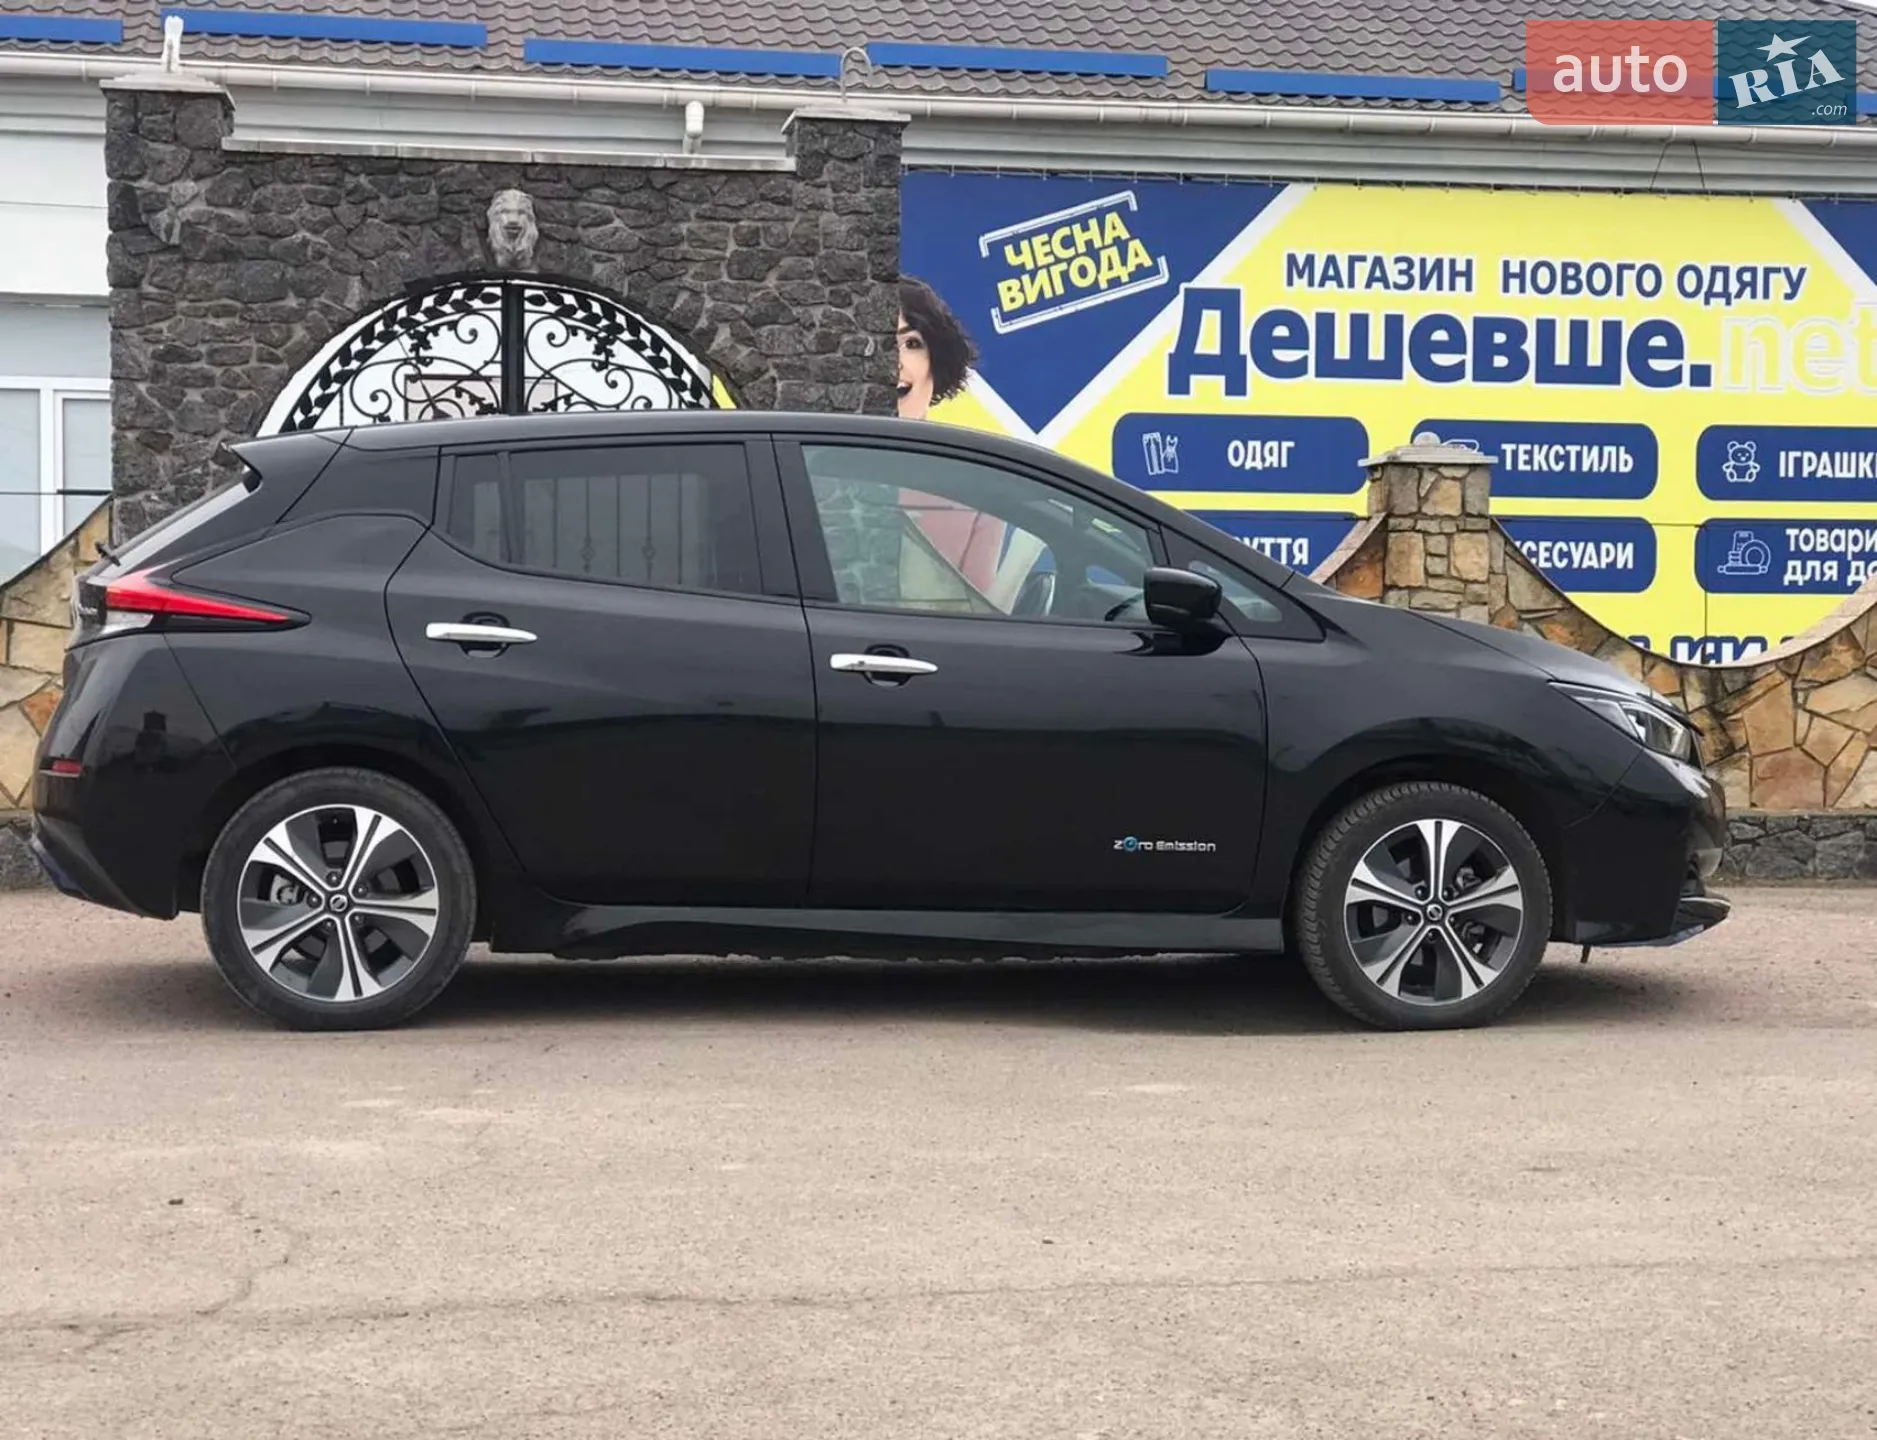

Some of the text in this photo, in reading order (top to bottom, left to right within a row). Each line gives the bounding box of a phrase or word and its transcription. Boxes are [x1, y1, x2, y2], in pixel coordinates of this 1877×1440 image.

[1004, 210, 1131, 271] ЧЕСНА
[997, 238, 1154, 312] ВИГОДА
[1286, 254, 1807, 306] МАГАЗИН НОВОГО ОДЯГУ
[1227, 440, 1295, 470] ОДЯГ
[1501, 443, 1634, 473] ТЕКСТИЛЬ
[1779, 451, 1877, 479] ІГРАШК
[1514, 541, 1634, 569] СЕСУАРИ
[1783, 560, 1838, 586] для
